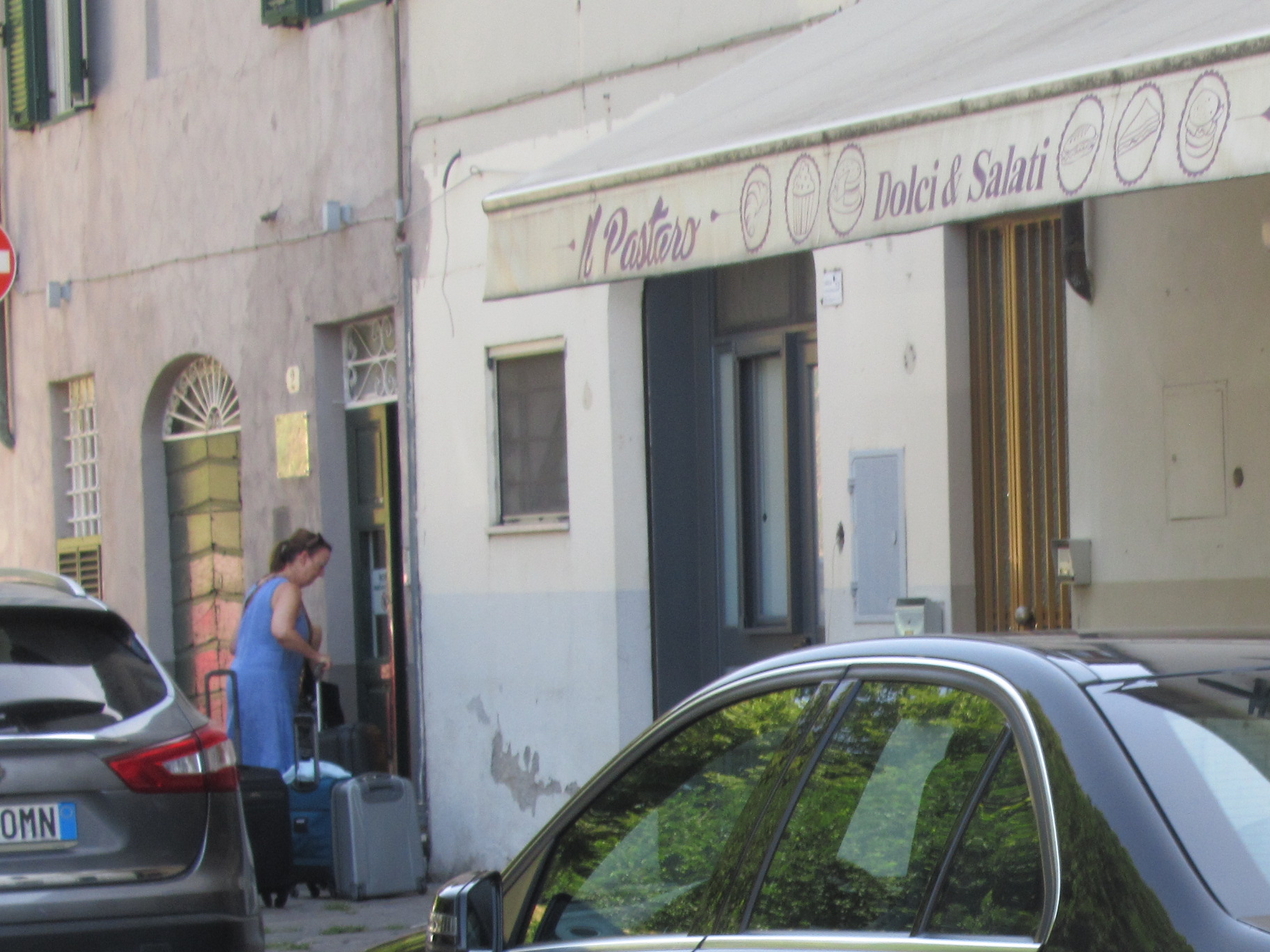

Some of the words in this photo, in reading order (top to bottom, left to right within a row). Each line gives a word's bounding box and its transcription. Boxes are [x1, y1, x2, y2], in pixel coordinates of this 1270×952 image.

[873, 159, 940, 221] Dolci
[942, 153, 963, 209] &
[967, 136, 1050, 203] Salati
[603, 195, 702, 275] Pastaro
